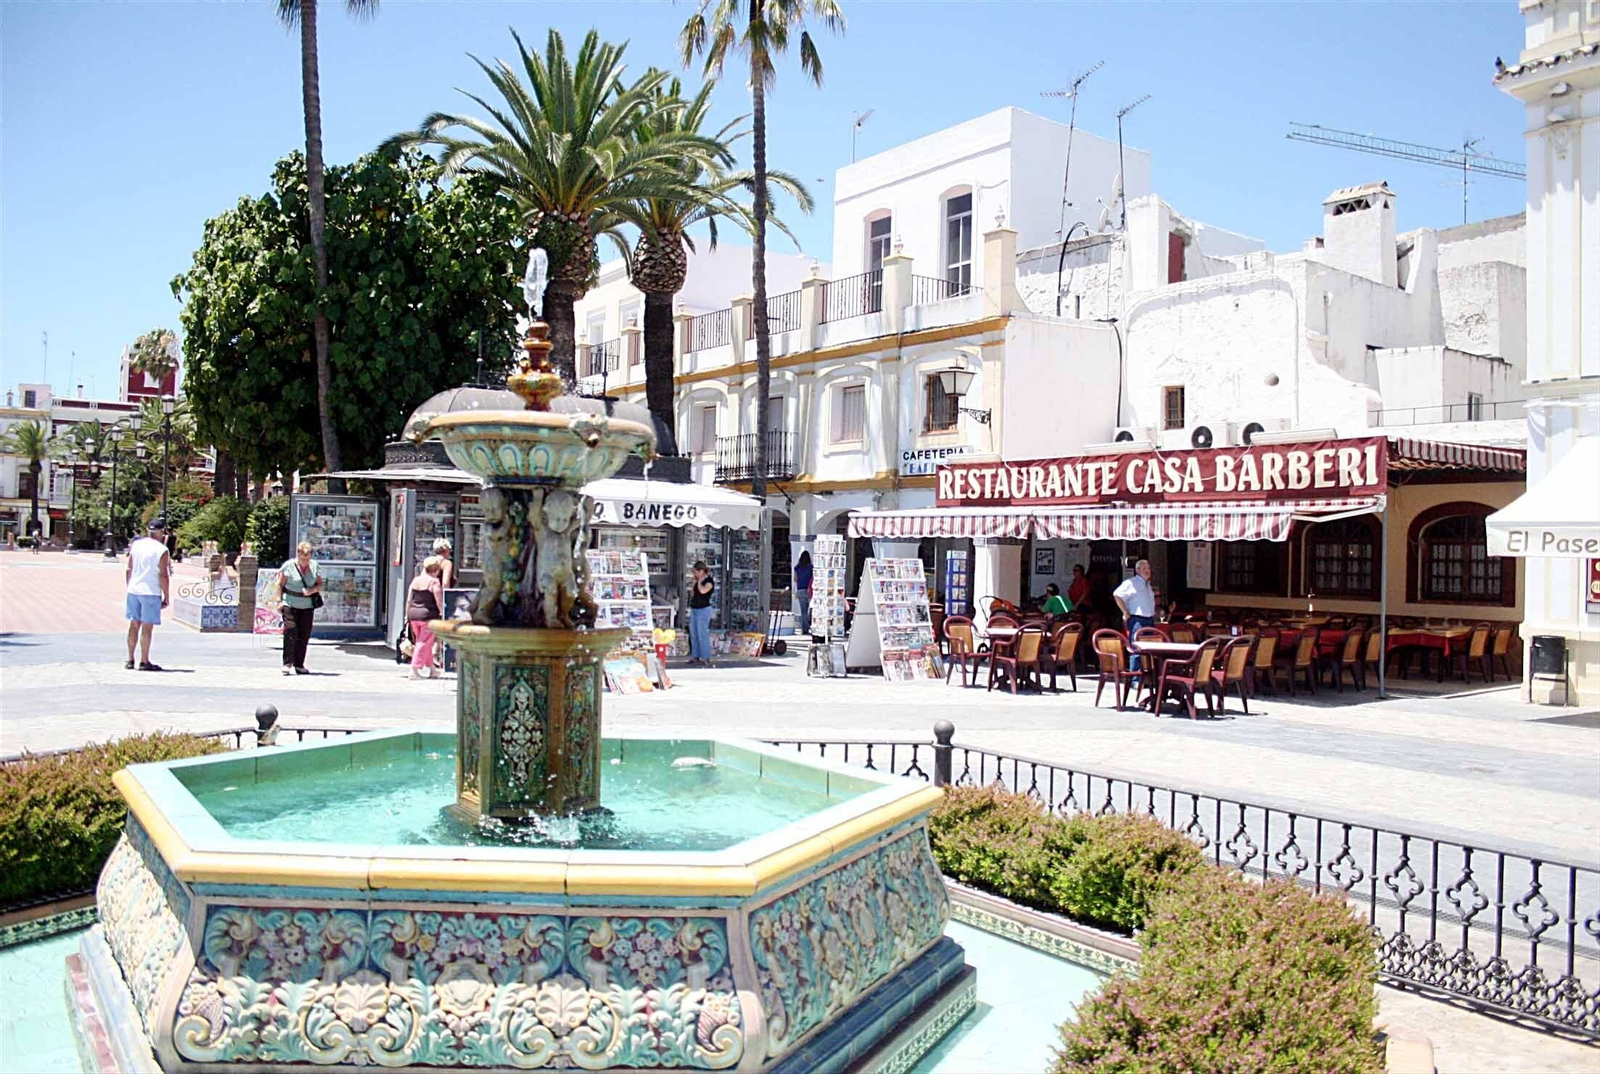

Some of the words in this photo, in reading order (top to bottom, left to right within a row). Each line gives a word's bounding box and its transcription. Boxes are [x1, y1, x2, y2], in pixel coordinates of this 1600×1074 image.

[938, 462, 1118, 499] RESTAURANTE
[1125, 457, 1203, 494] CASA
[1214, 445, 1380, 493] BARBERI
[623, 502, 698, 520] BANEGO
[1507, 530, 1529, 552] El
